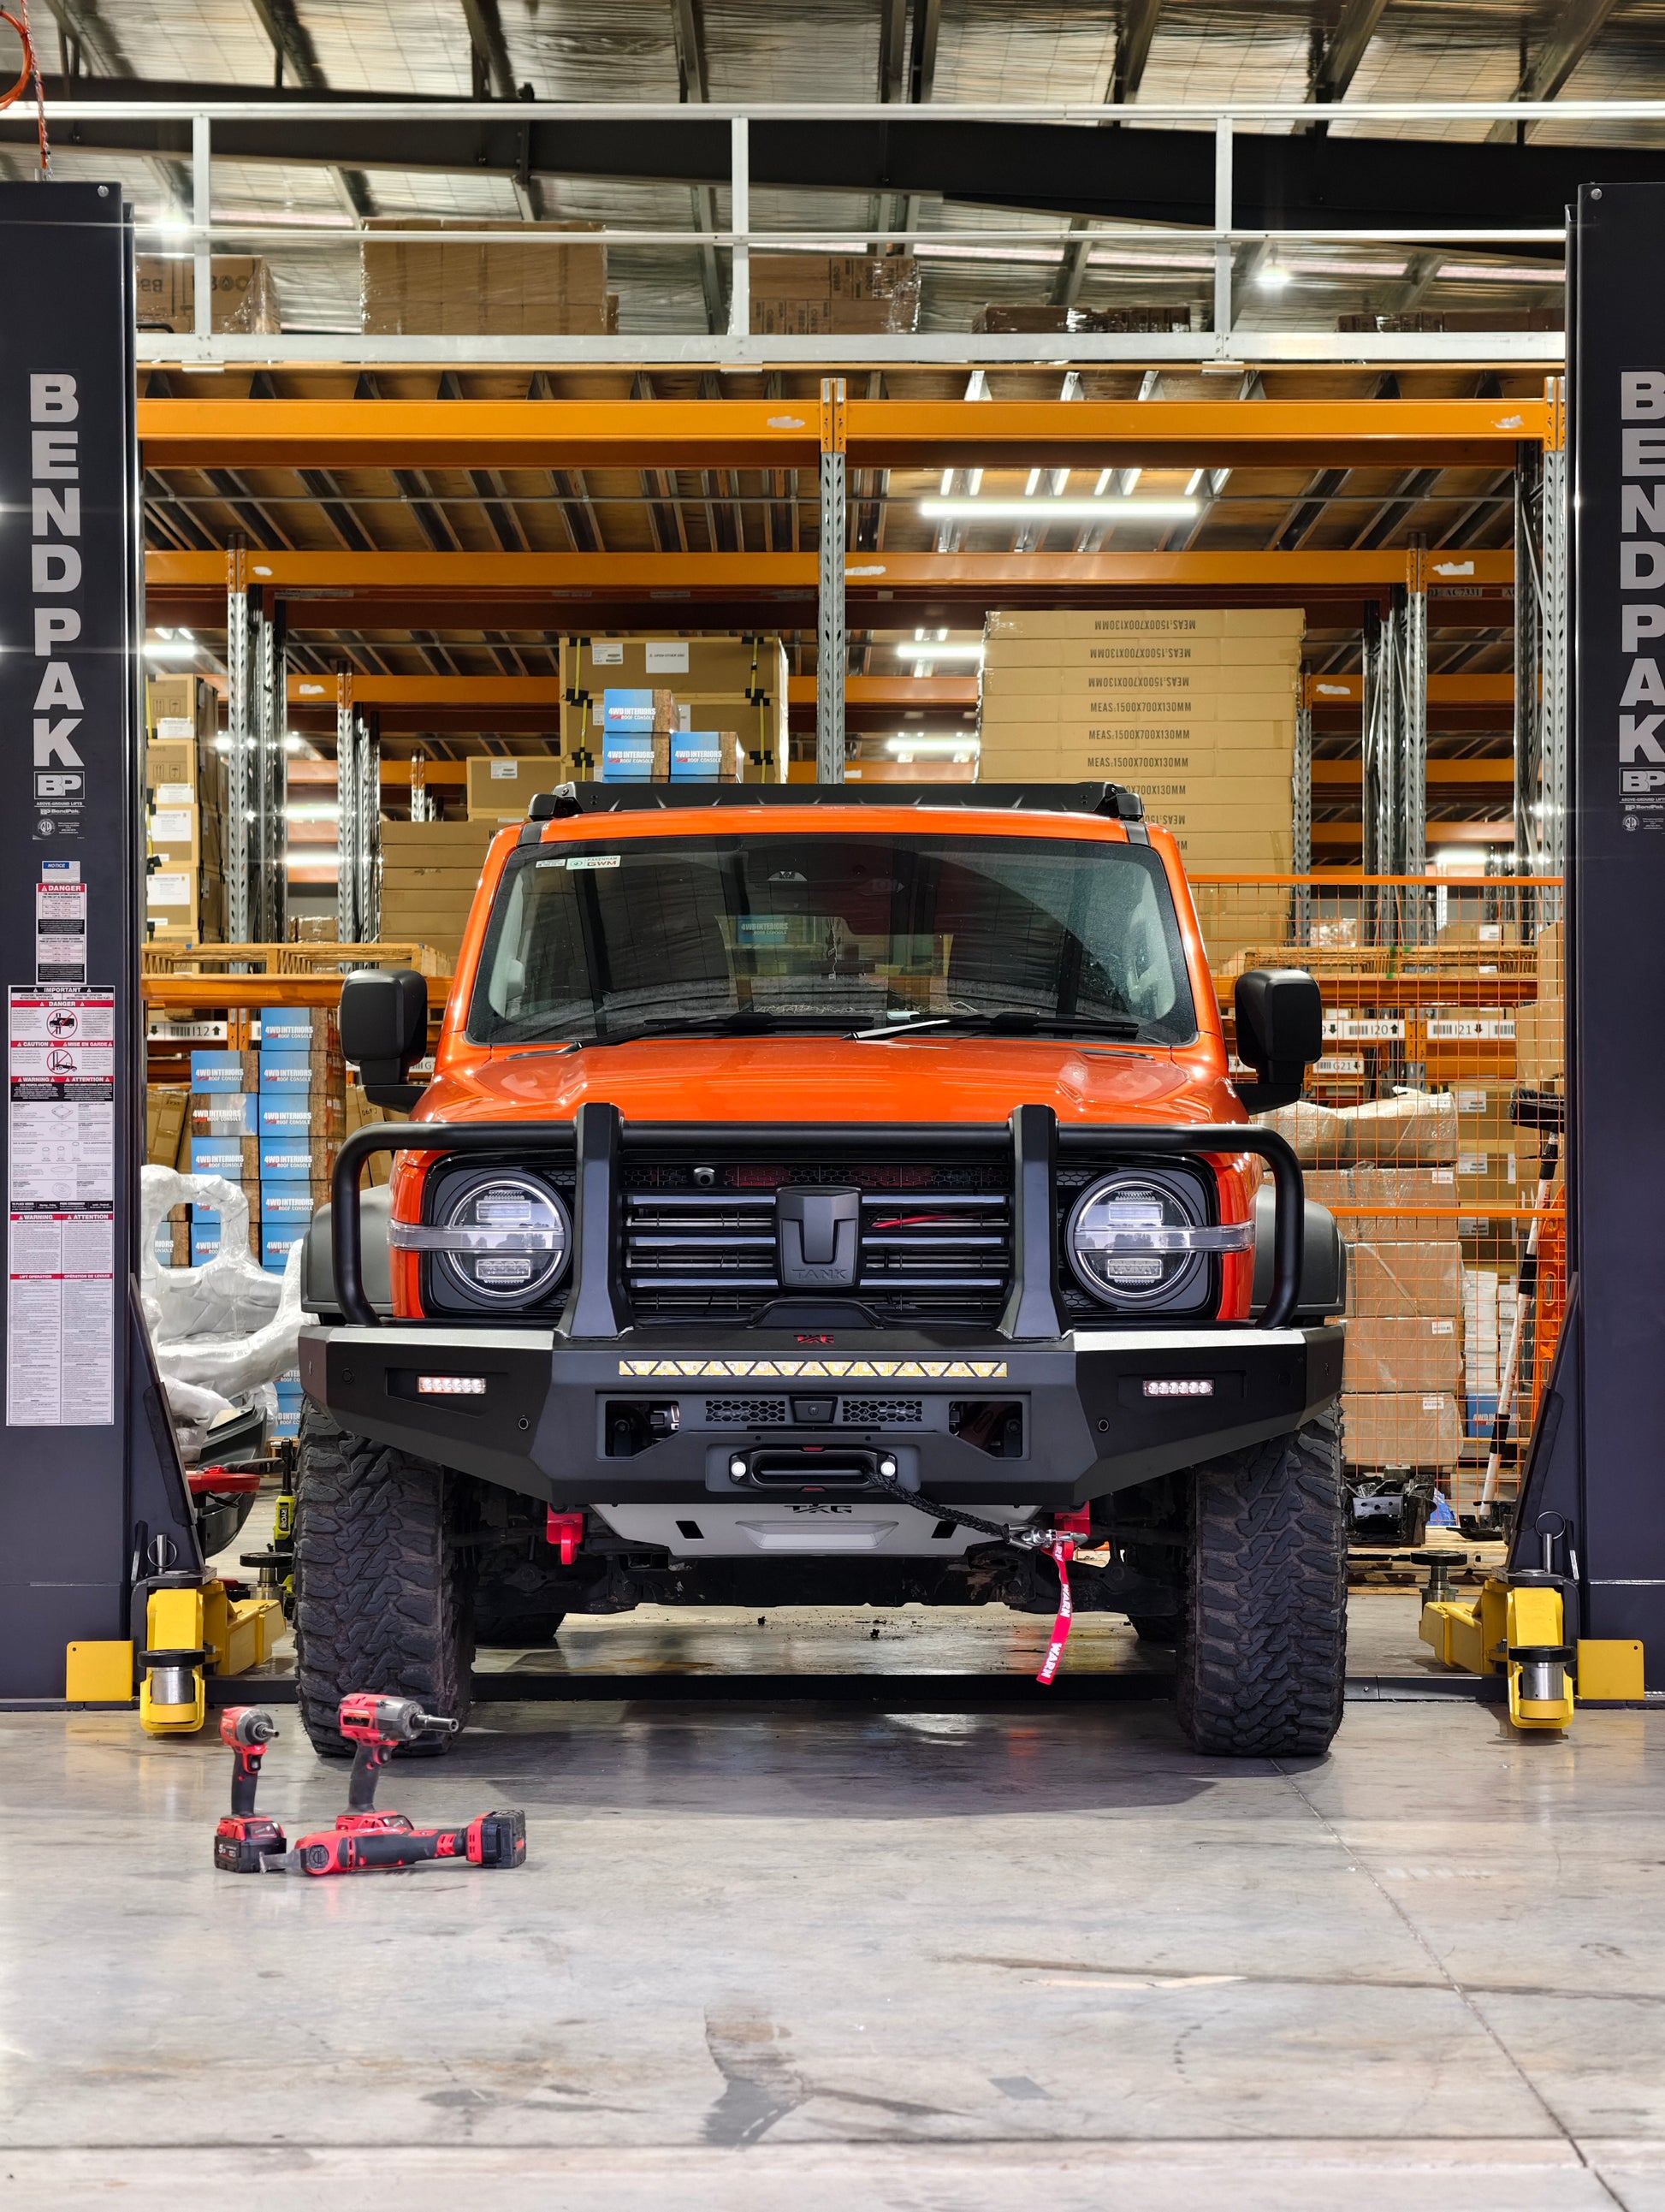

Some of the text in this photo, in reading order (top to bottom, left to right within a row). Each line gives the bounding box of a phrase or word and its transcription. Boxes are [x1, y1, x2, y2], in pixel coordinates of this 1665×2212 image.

[30, 373, 85, 767] BENDPAK
[1619, 371, 1665, 763] BENDPAK
[1446, 588, 1479, 596] AC7331
[1094, 620, 1196, 630] MEAS:1500X700X130MM
[1090, 648, 1191, 658] MEAS:1500X700X130MM
[1088, 677, 1189, 687] MEAS:1500X700X130MM
[1090, 702, 1192, 712] MEAS:1500X700X130MM
[1088, 730, 1190, 740] MEAS:1500X700X130MM
[1087, 757, 1188, 768] MEAS:1500X700X130MM
[38, 775, 82, 796] BP
[1623, 771, 1665, 792] BP
[193, 1109, 241, 1118] 4WD INTERIORS
[791, 1269, 848, 1280] TANK
[1059, 1583, 1071, 1617] WARN
[1040, 1642, 1063, 1679] WARN
